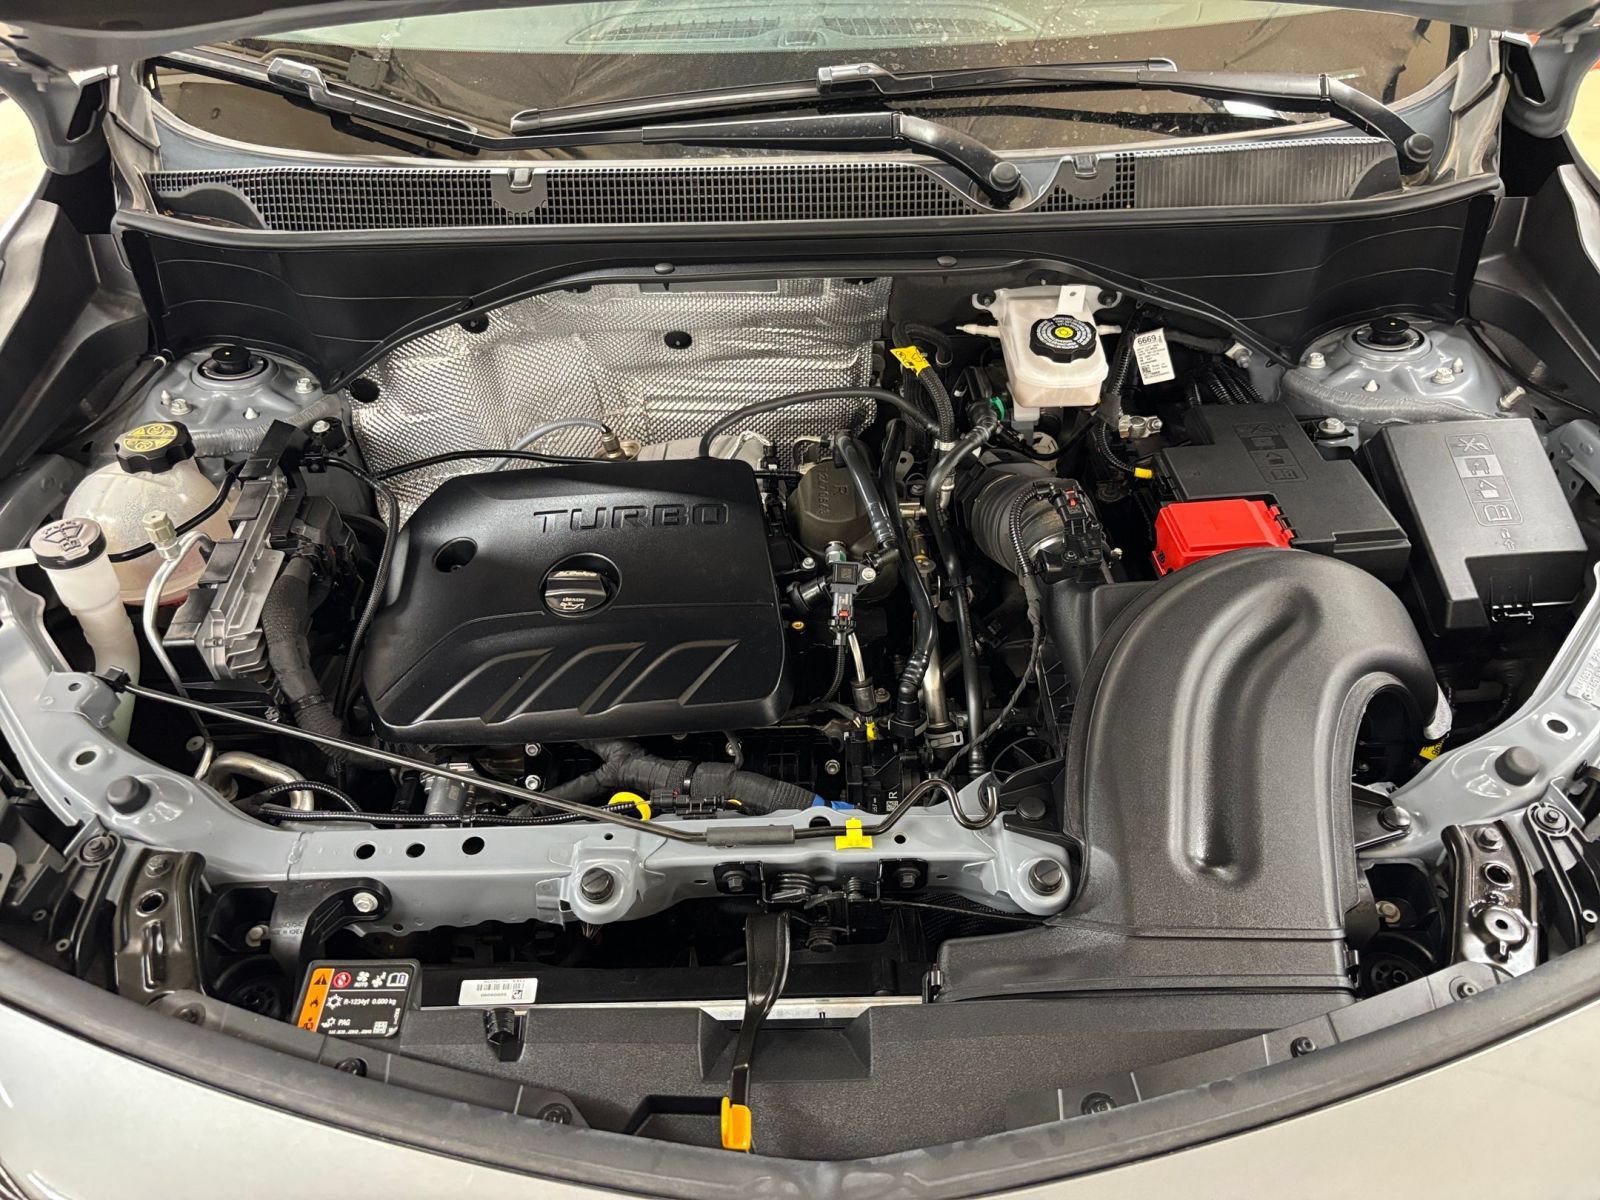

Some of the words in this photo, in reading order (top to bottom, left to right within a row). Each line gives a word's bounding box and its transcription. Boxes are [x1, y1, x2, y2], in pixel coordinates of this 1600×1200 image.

[1137, 335, 1157, 345] 6669
[533, 503, 729, 533] TURBO
[888, 791, 898, 799] R
[388, 998, 397, 1006] kg
[337, 1018, 351, 1026] PAG
